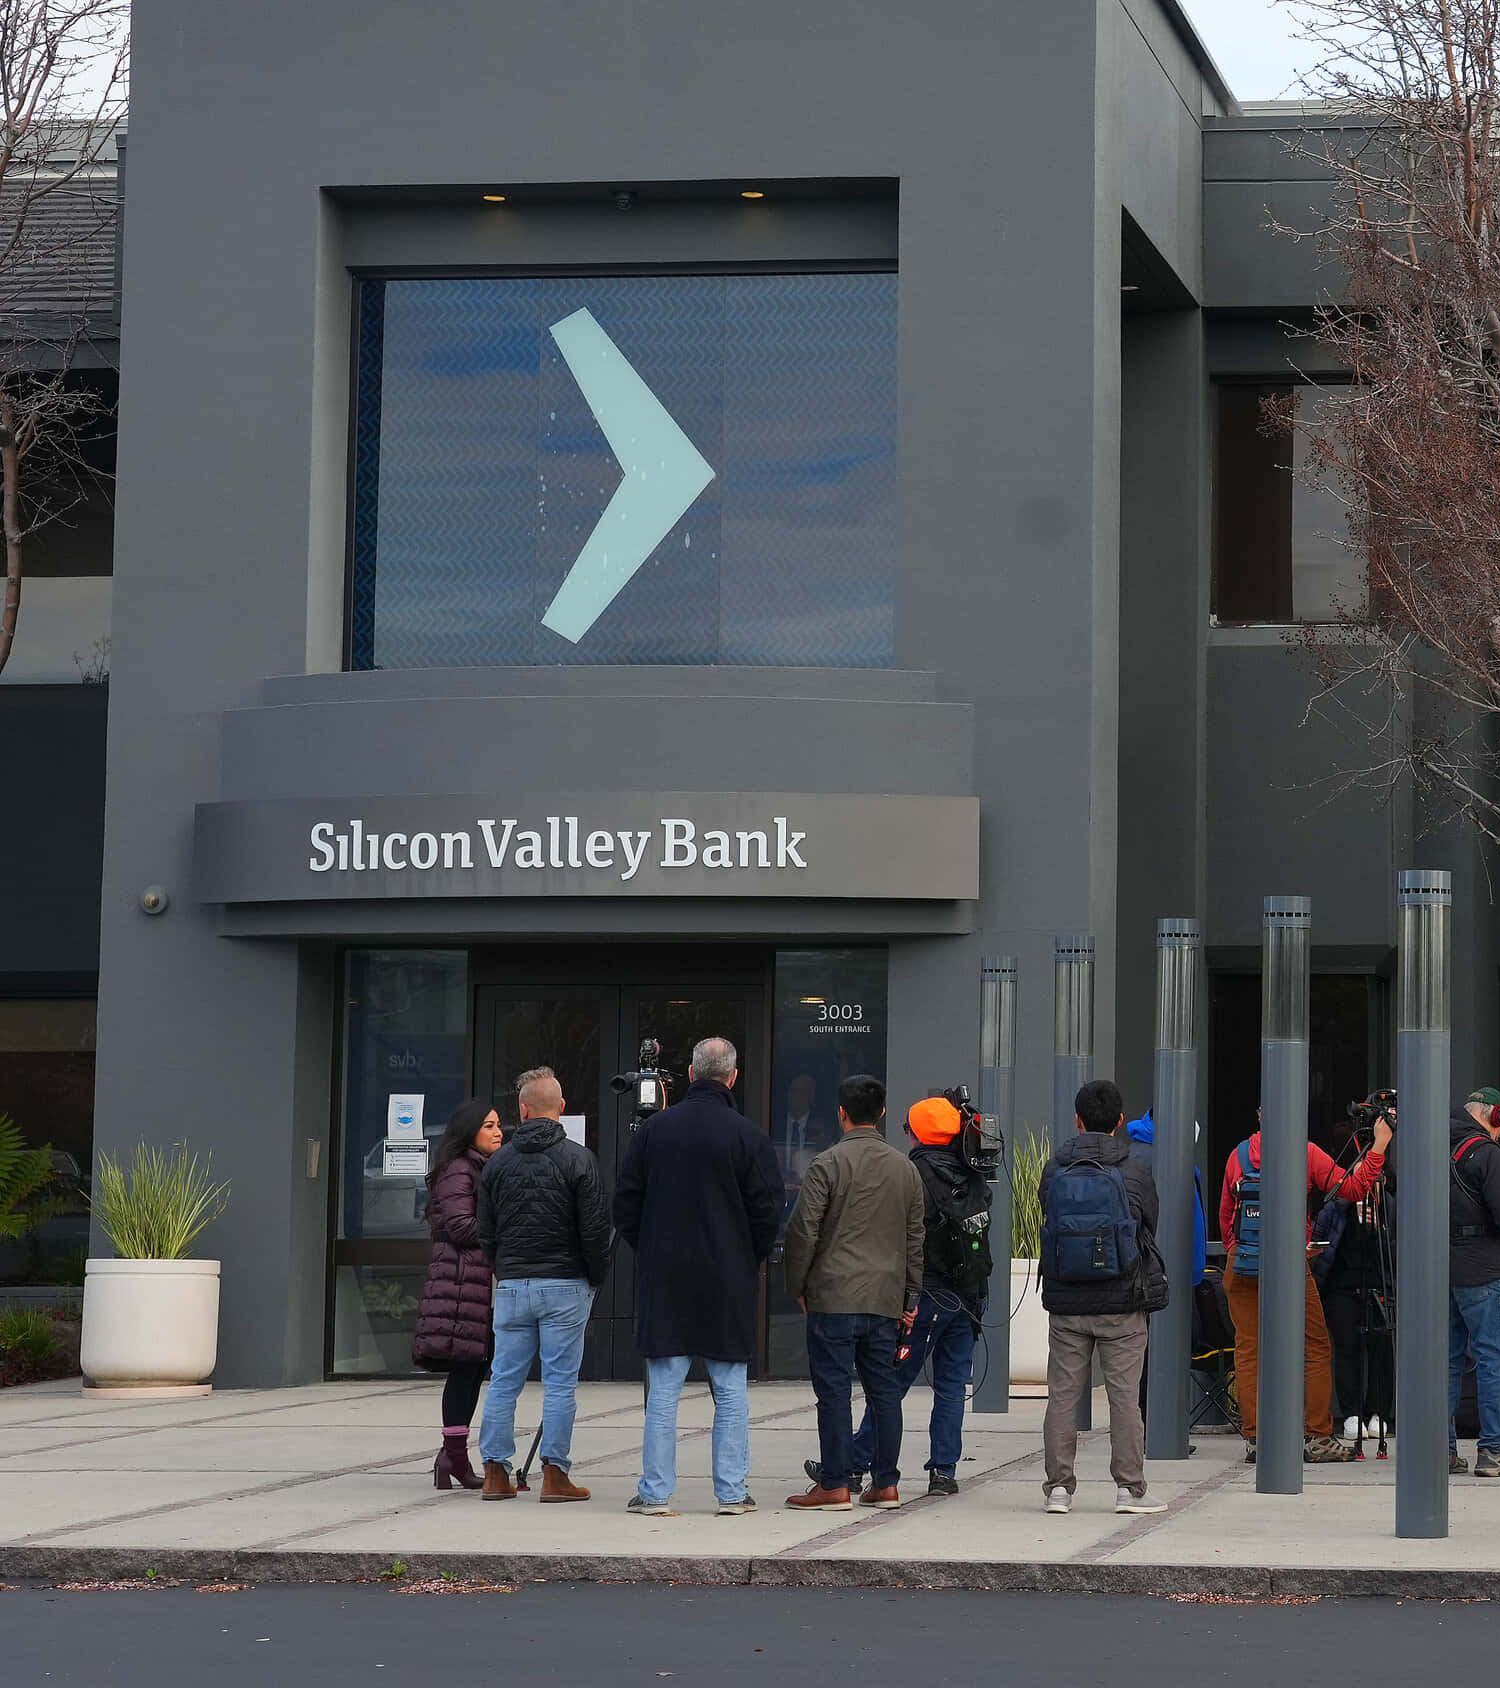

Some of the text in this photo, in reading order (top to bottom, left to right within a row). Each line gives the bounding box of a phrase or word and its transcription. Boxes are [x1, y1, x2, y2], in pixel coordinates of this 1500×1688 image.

[309, 816, 808, 881] Silicon Valley Bank
[818, 1004, 863, 1021] 3003
[809, 1025, 872, 1033] SOUTH ENTRANCE
[389, 1048, 416, 1066] svb
